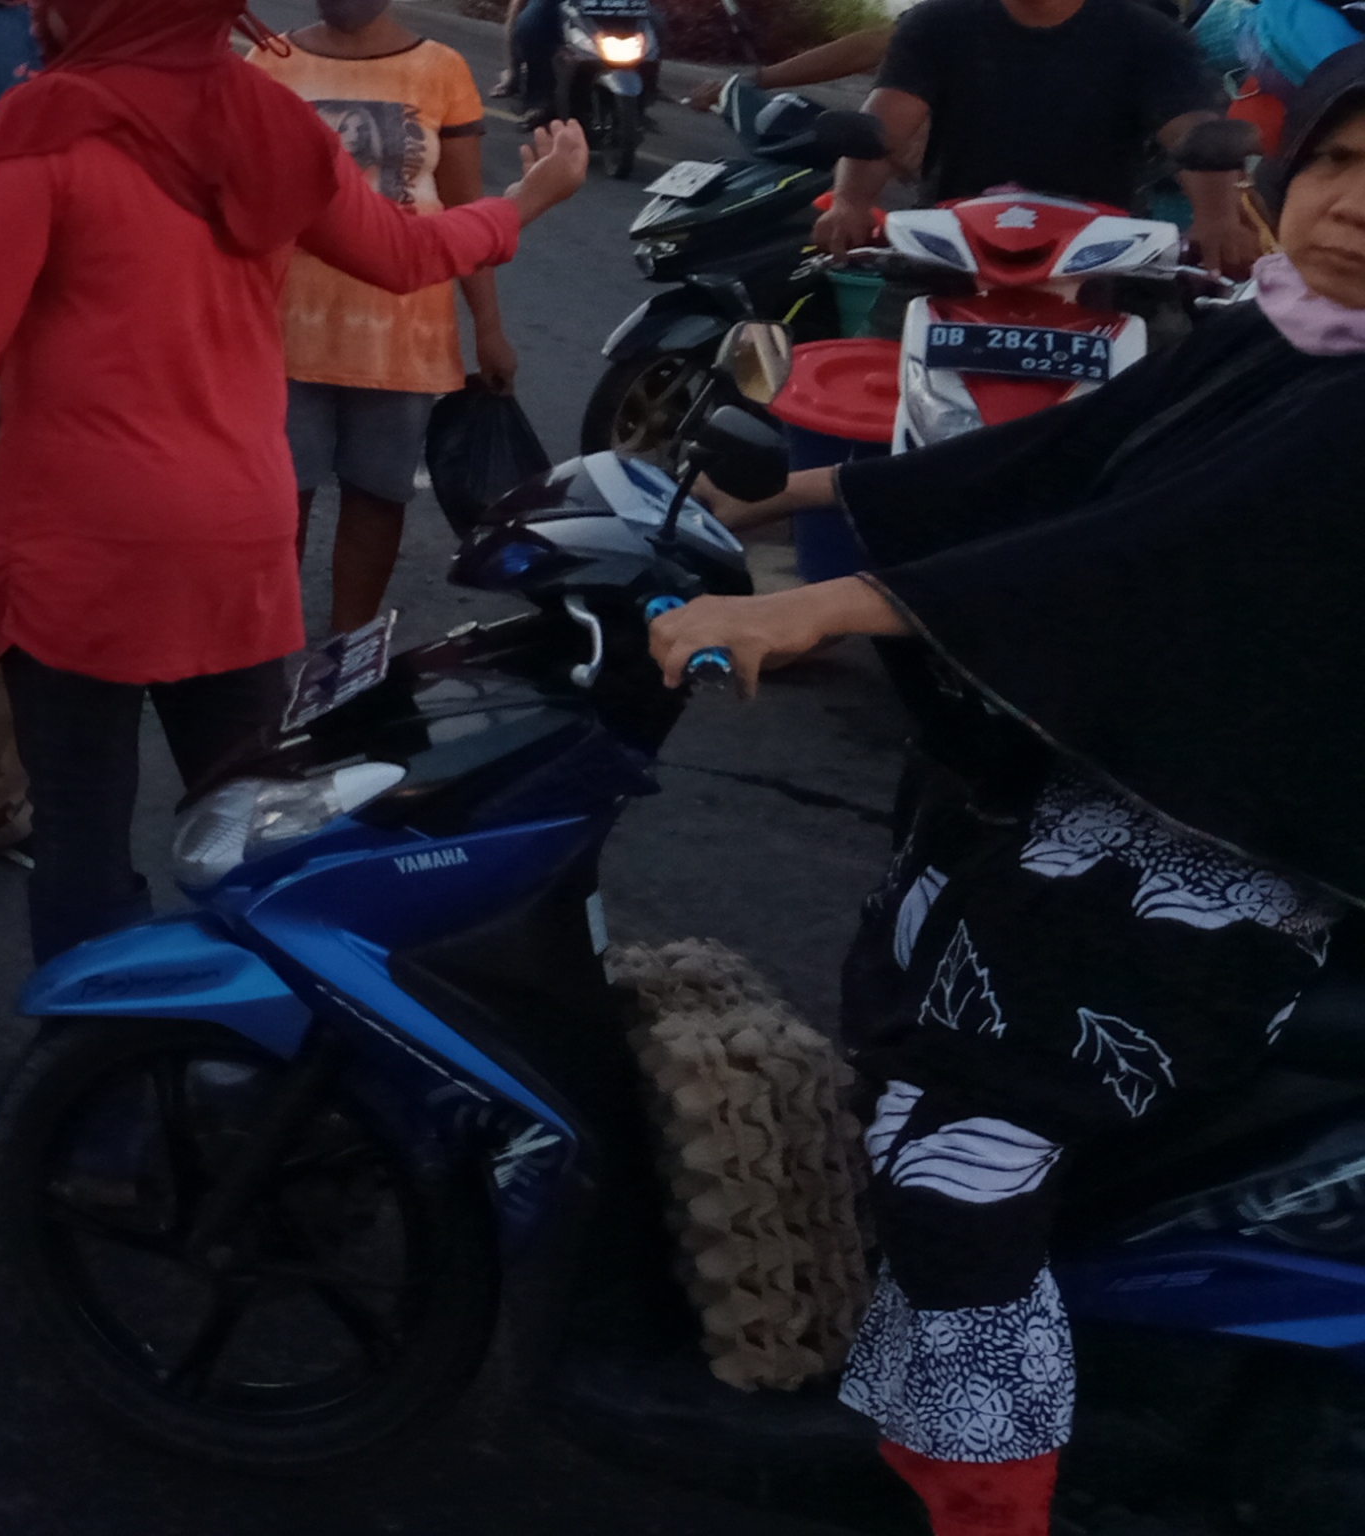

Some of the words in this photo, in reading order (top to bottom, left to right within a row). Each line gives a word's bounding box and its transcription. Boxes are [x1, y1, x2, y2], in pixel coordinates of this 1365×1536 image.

[931, 326, 966, 347] DB
[986, 328, 1055, 353] 2841
[1070, 335, 1108, 360] FA
[393, 846, 469, 875] YAMAHA
